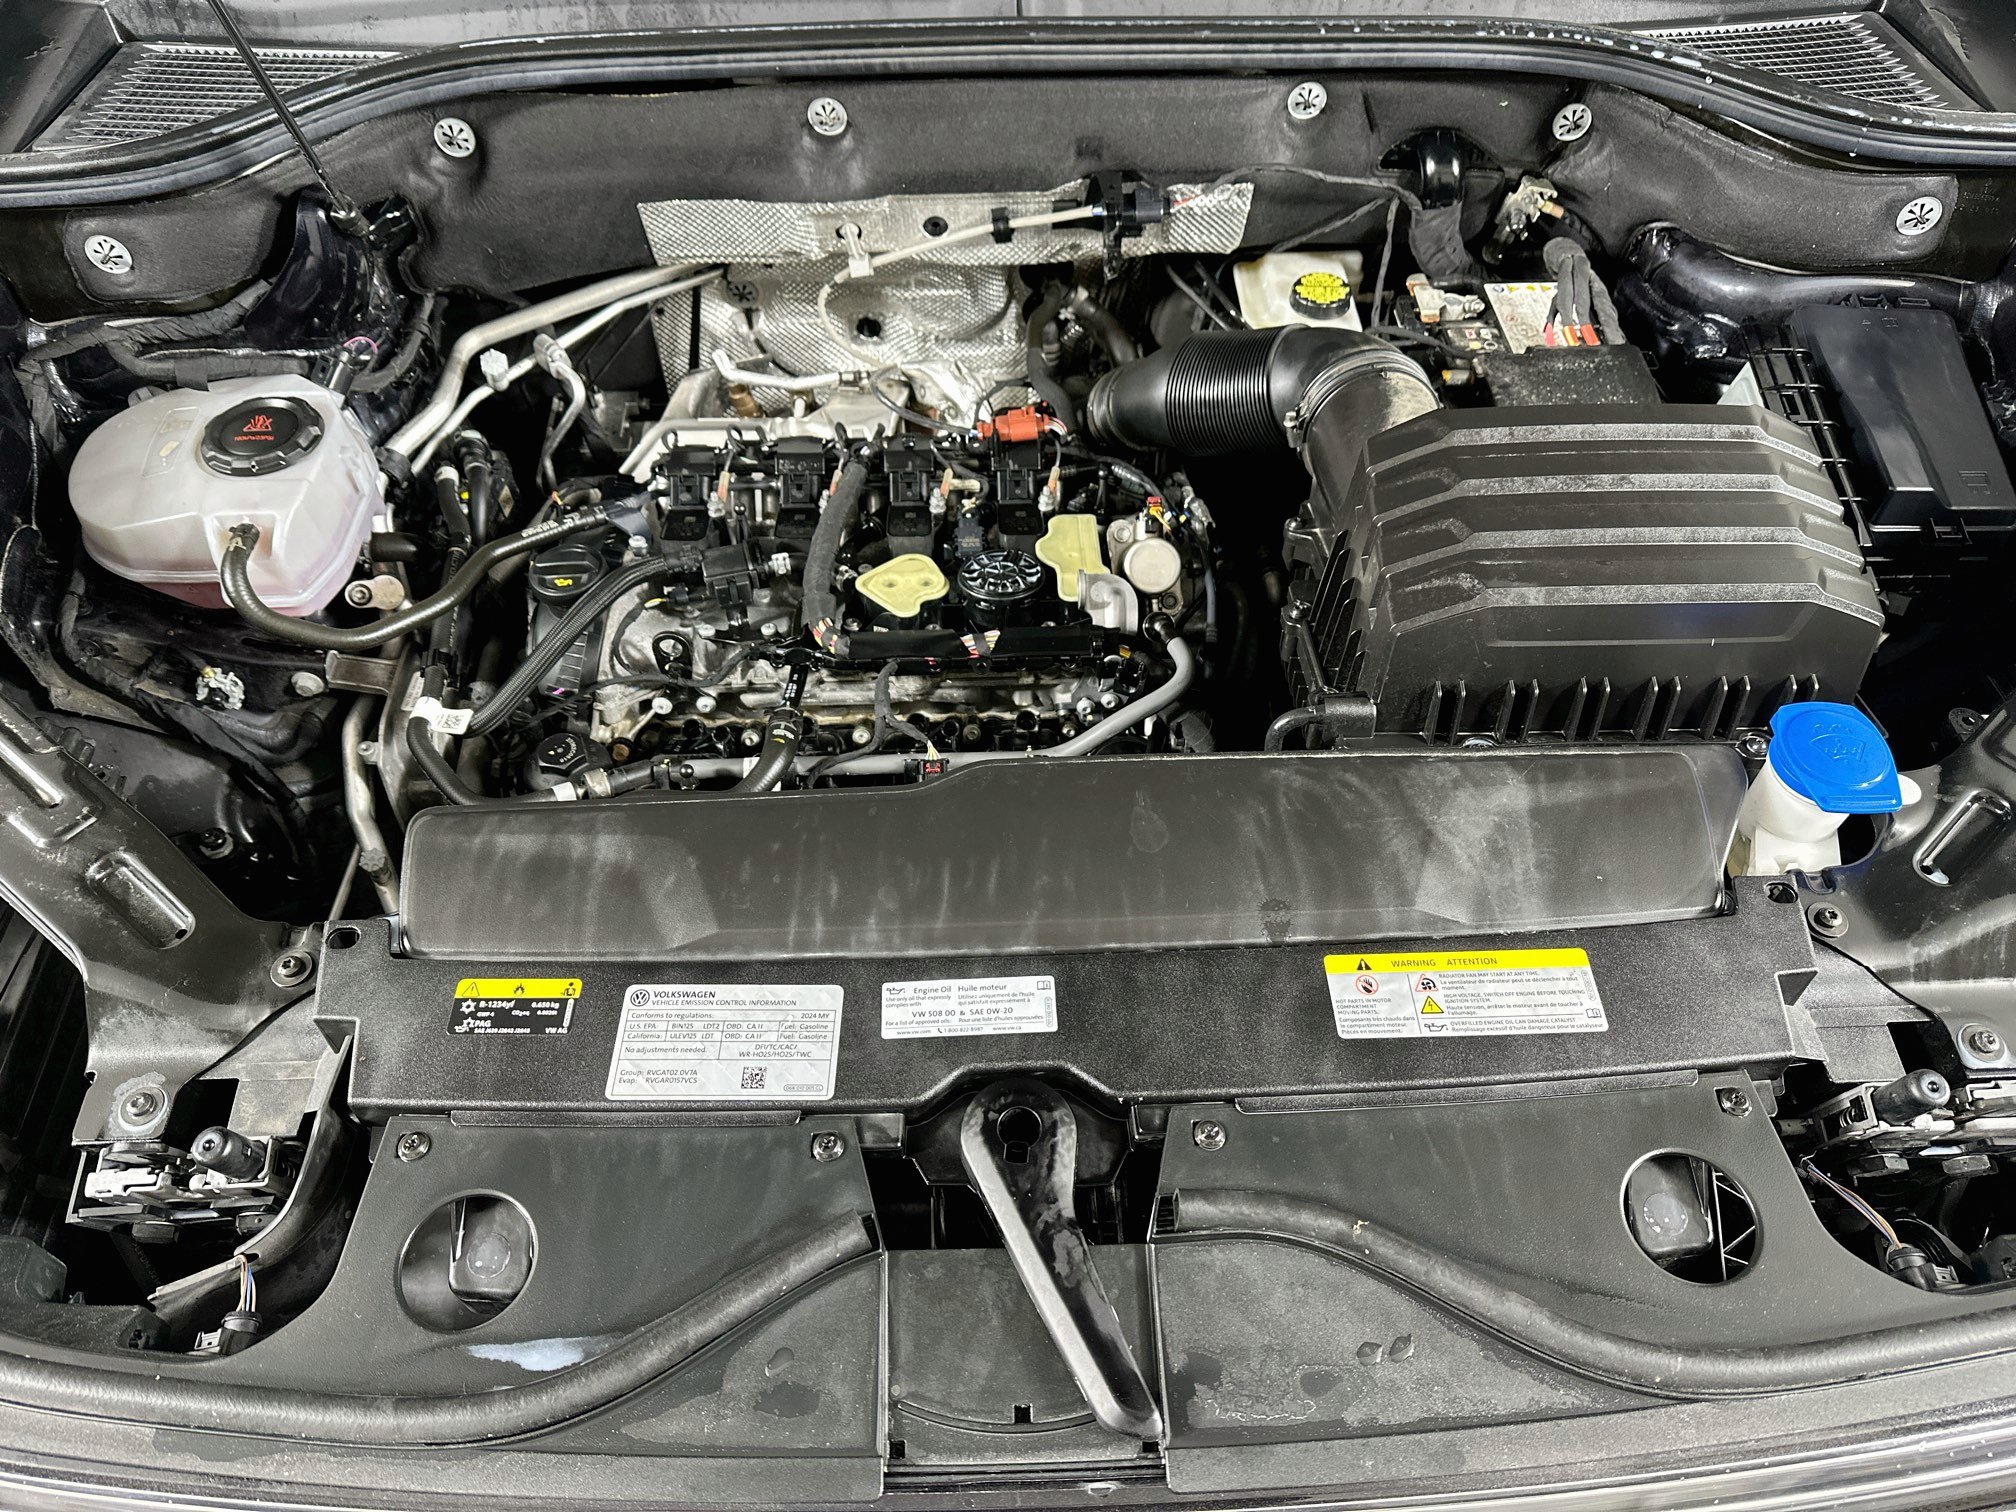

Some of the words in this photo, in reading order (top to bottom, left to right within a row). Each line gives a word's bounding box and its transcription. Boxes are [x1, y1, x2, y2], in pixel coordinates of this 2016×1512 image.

[1391, 959, 1436, 968] WARNING
[1447, 957, 1498, 966] ATTENTION
[653, 990, 716, 999] VOLKSWAGEN
[913, 987, 939, 995] Engine
[478, 999, 516, 1009] R-1234yf
[550, 1001, 560, 1009] kg
[636, 1046, 679, 1055] adjustments
